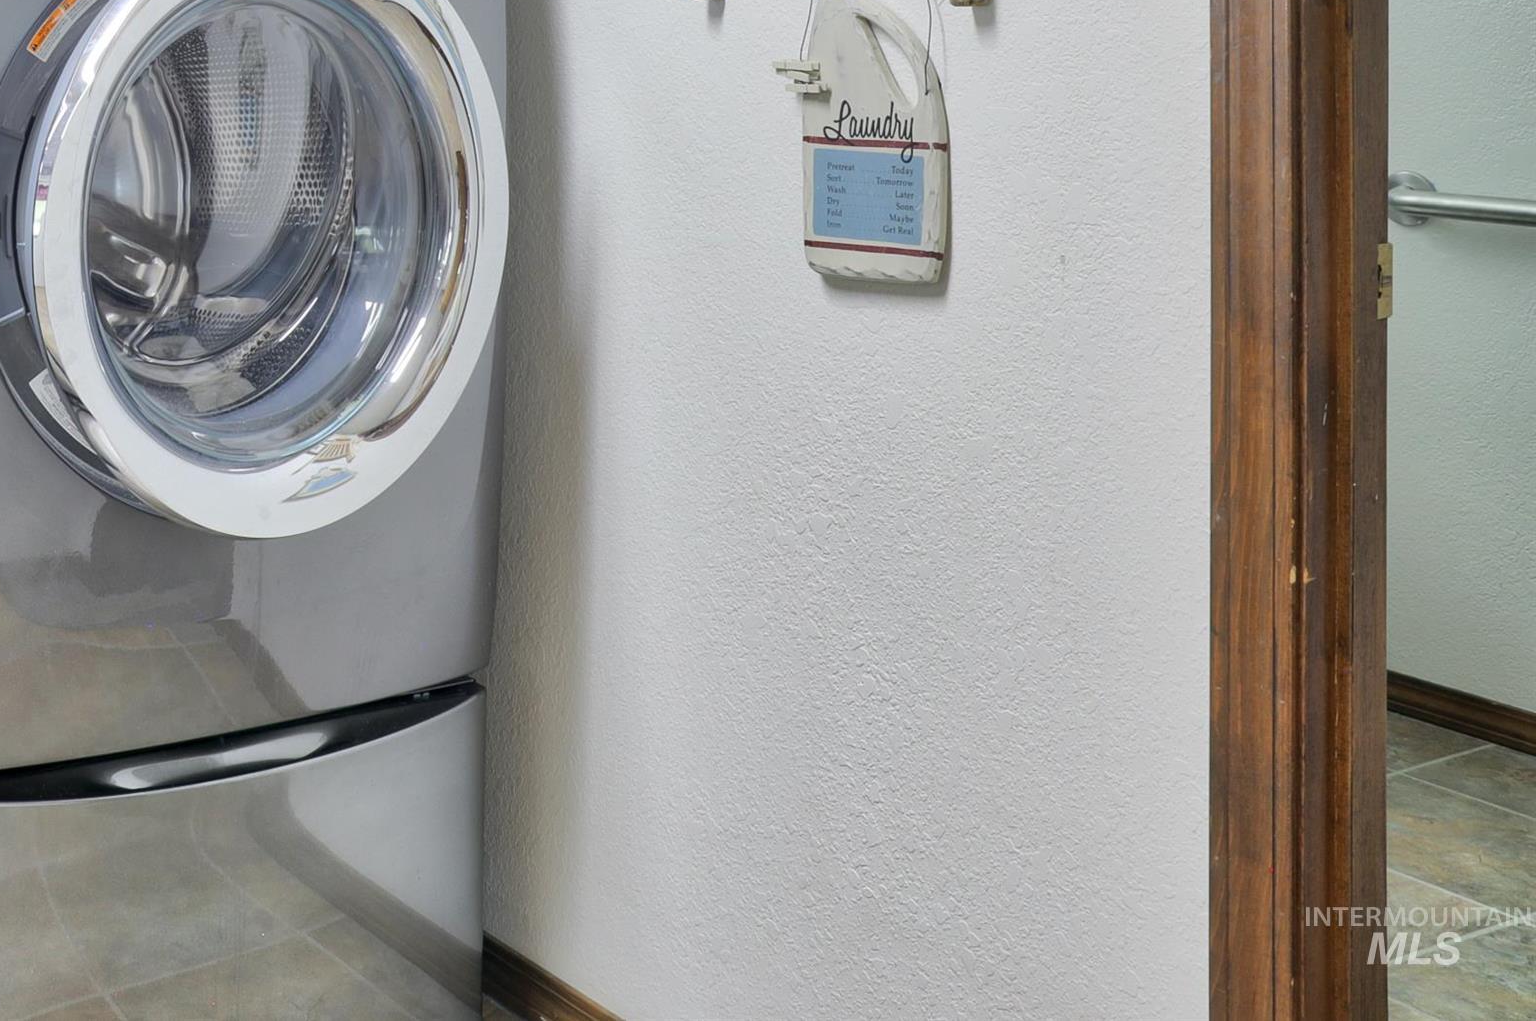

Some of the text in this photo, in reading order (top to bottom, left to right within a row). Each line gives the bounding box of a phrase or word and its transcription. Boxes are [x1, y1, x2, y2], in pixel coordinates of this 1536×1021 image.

[823, 99, 916, 164] Laundry
[827, 161, 914, 176] Pretreat Today
[876, 176, 914, 187] Tomorrow
[827, 185, 914, 200] Wash Later
[827, 196, 915, 212] Dry Soon
[827, 208, 914, 225] Fold Maybe
[882, 224, 897, 234] Get
[898, 225, 914, 235] Real
